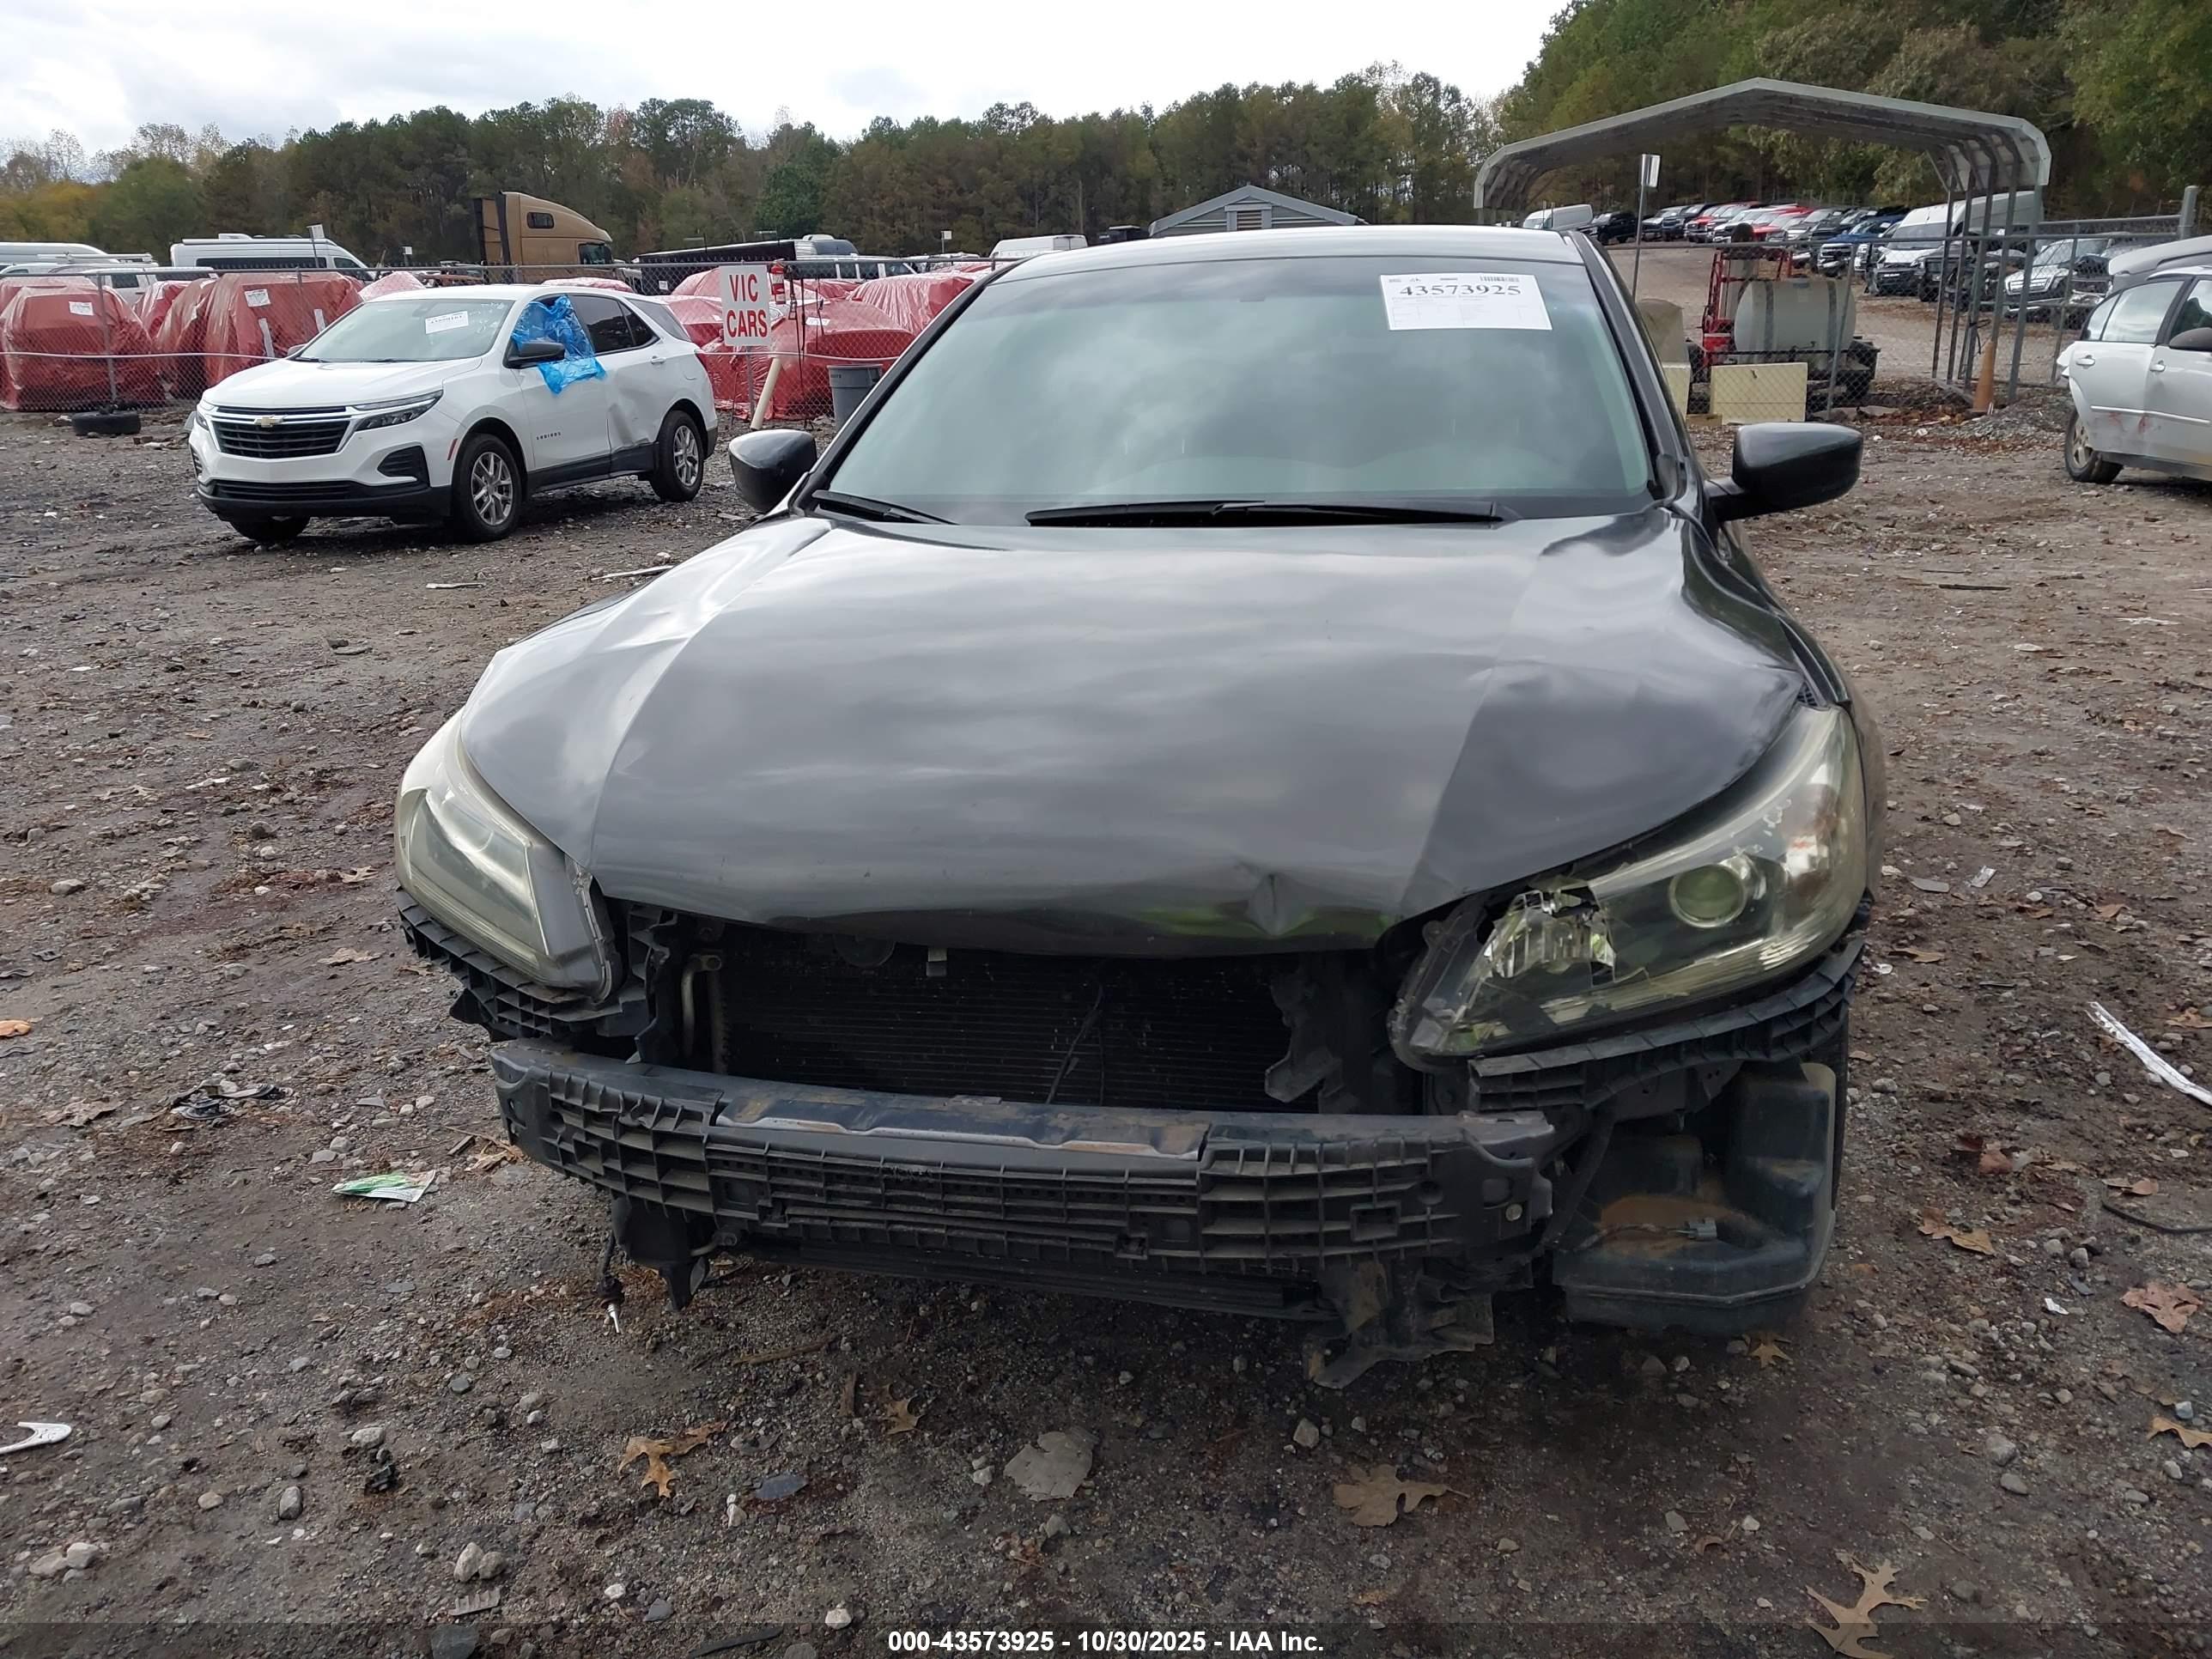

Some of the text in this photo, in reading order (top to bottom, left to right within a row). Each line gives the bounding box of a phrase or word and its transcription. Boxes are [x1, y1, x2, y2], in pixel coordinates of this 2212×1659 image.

[729, 274, 758, 302] VIC
[1400, 284, 1522, 296] 43573925
[726, 309, 768, 338] CARS
